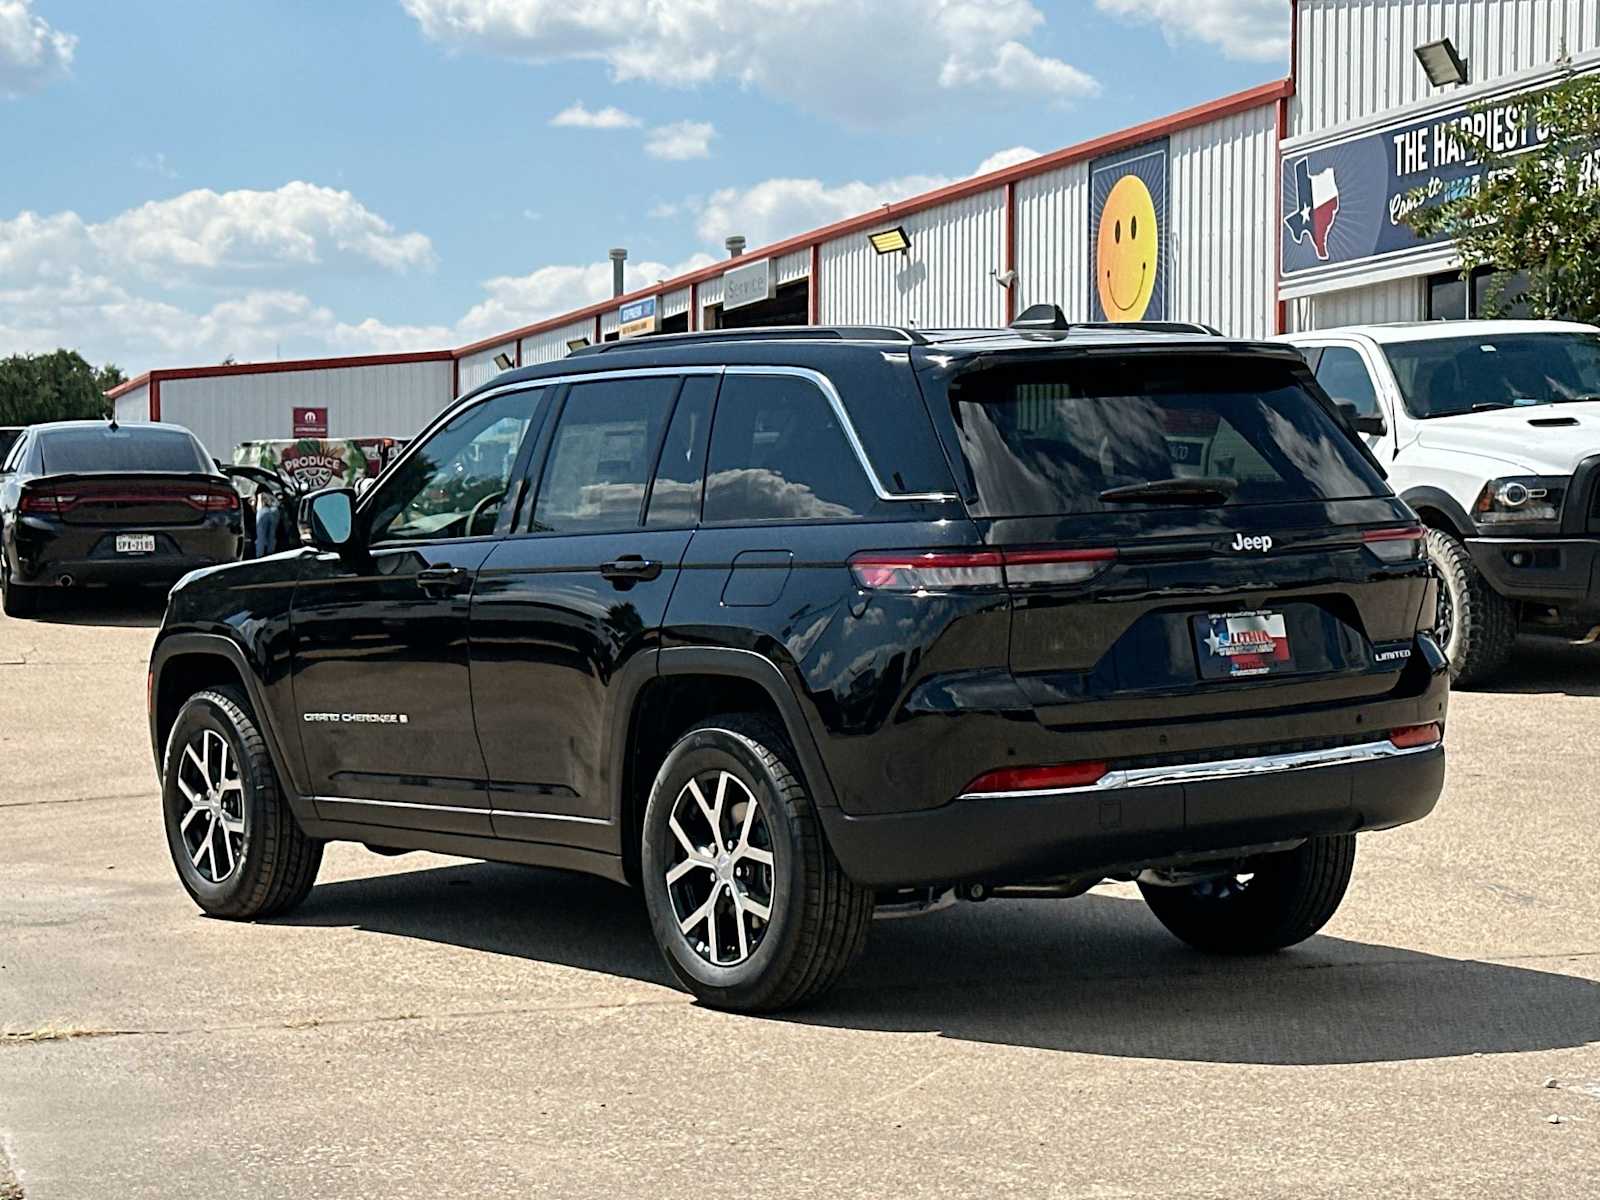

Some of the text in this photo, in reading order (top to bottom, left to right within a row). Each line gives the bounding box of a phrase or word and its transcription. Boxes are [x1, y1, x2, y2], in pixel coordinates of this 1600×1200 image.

[1393, 127, 1429, 177] THE
[284, 455, 341, 472] PRODUCE
[1232, 533, 1273, 553] Jeep
[1375, 649, 1412, 662] LIMITED
[304, 713, 398, 723] GRAND CHEROKEE
